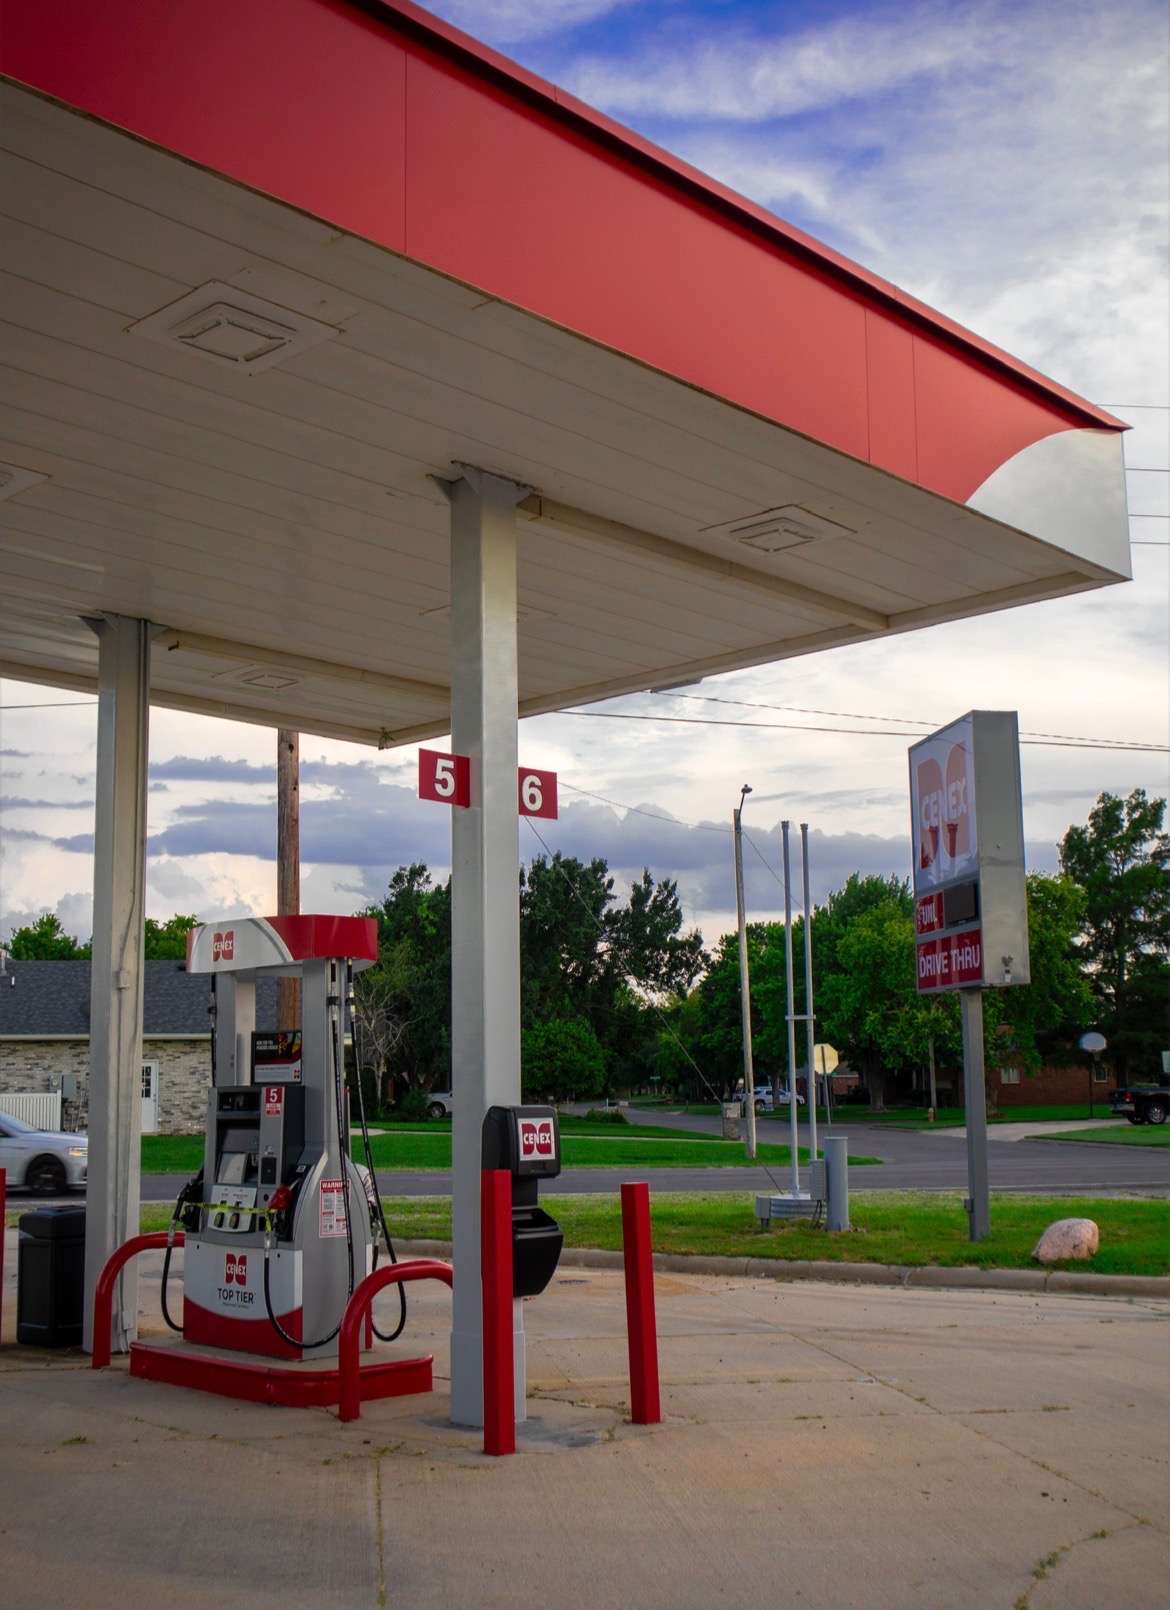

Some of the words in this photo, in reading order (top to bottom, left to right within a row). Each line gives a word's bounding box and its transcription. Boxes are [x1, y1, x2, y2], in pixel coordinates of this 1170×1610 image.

[434, 758, 455, 797] 5
[522, 775, 543, 812] 6
[920, 776, 968, 825] CENEX
[213, 939, 233, 952] CENEX
[919, 951, 949, 978] DRIVE
[950, 944, 980, 972] THRU
[269, 1088, 278, 1103] 5
[523, 1132, 552, 1145] CENEX
[226, 1263, 247, 1276] CENEX
[217, 1287, 234, 1301] TOP
[235, 1290, 254, 1305] TIER
